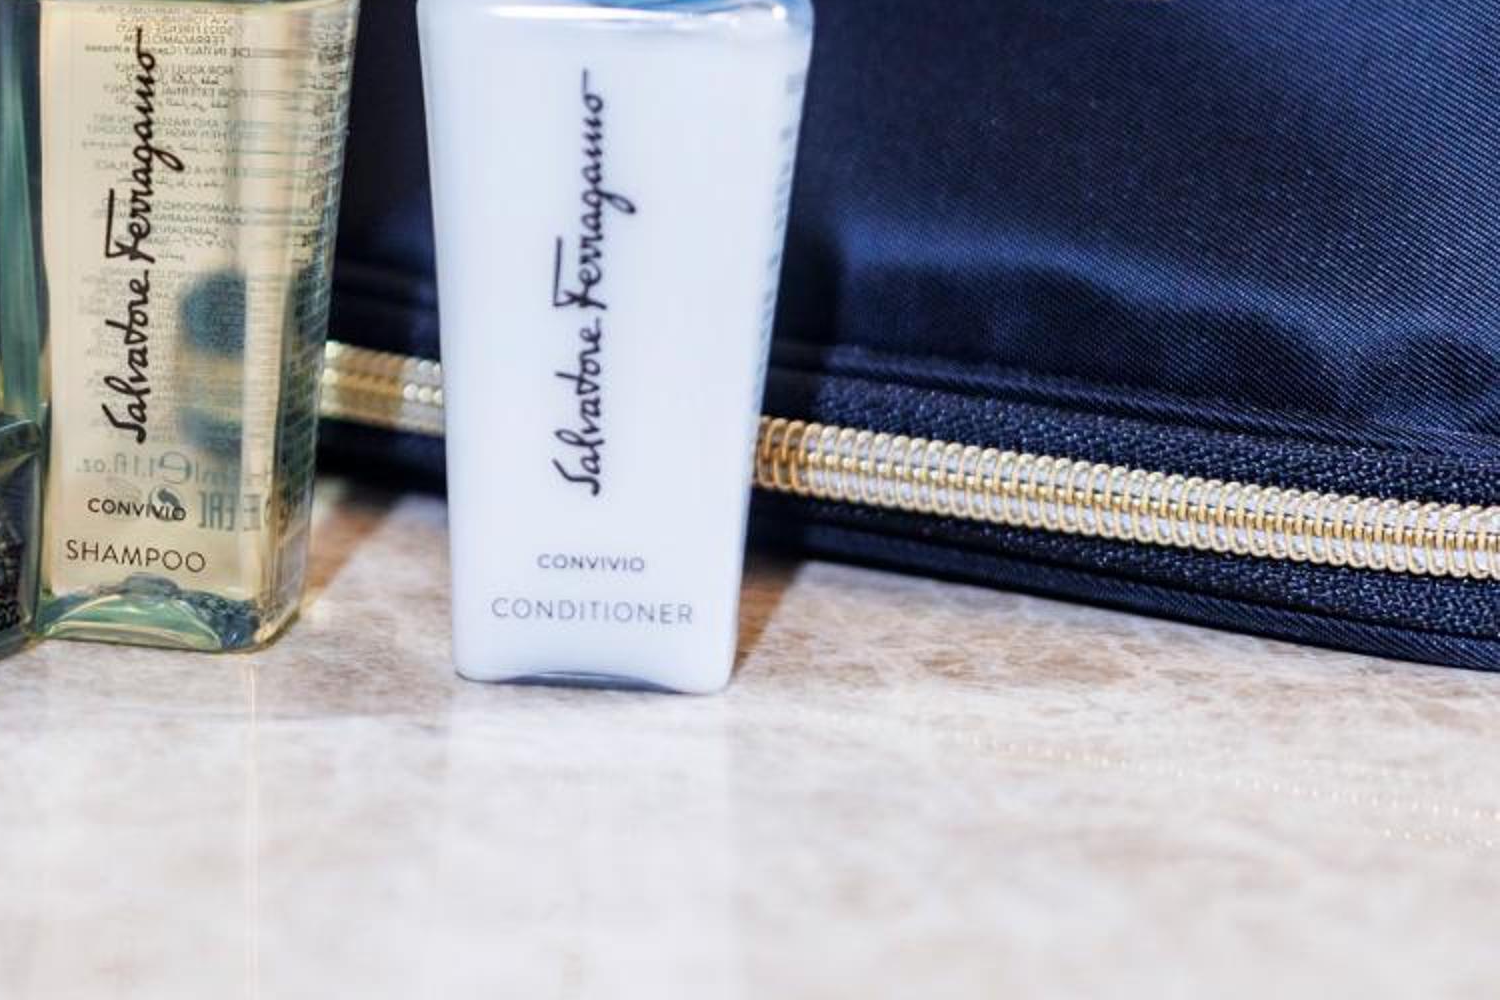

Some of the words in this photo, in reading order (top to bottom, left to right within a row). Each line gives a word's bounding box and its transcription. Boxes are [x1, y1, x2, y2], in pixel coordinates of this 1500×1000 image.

[105, 27, 184, 264] Ferragamo
[553, 69, 636, 311] Ferragamo
[101, 272, 152, 445] Salvatore
[552, 316, 602, 497] Salvatore
[65, 538, 207, 574] SHAMPOO
[87, 497, 187, 522] CONVIVIO
[490, 595, 694, 626] CONDITIONER
[536, 552, 646, 573] CONVIVIO
